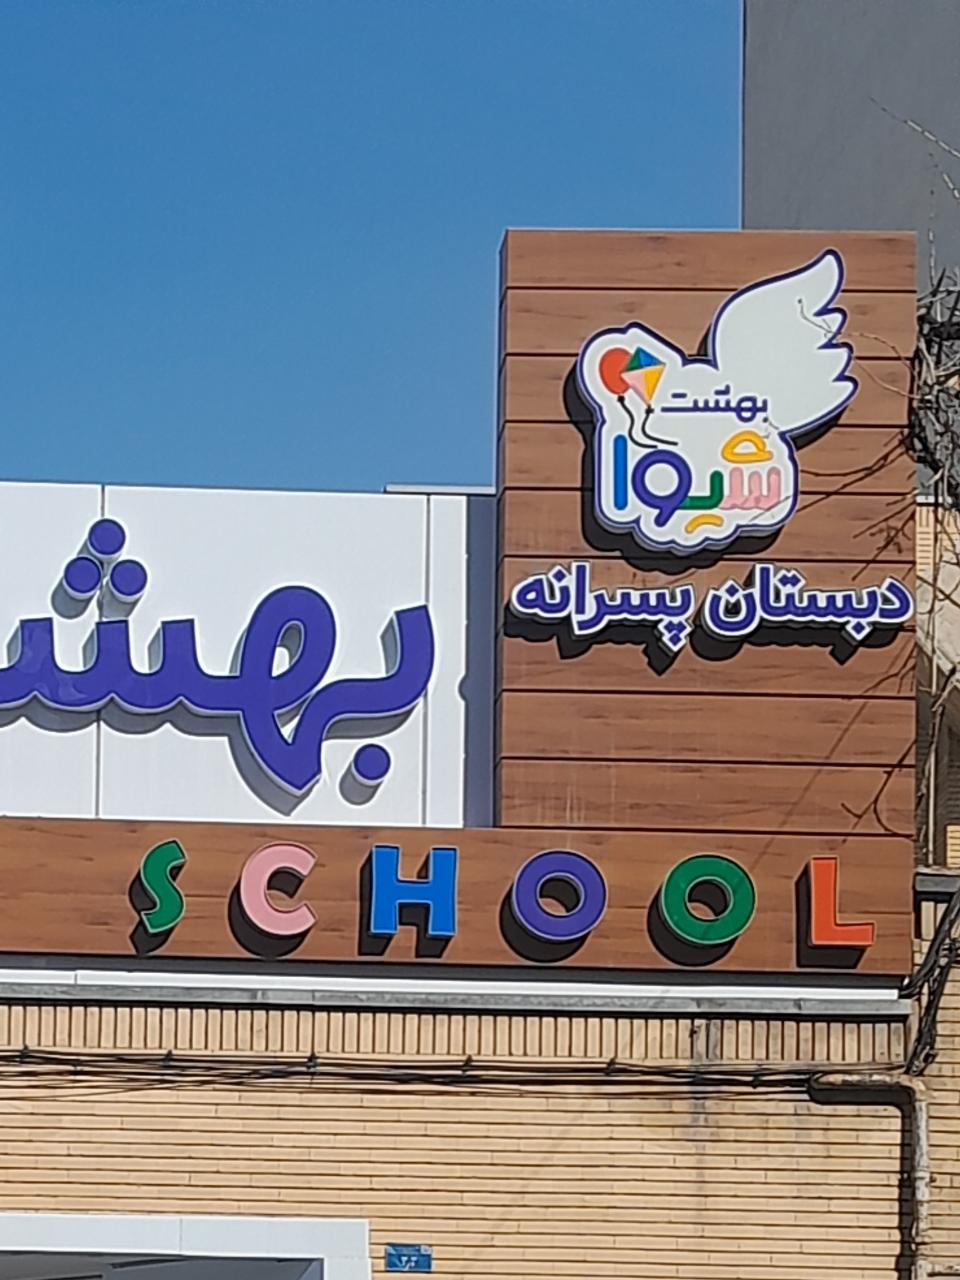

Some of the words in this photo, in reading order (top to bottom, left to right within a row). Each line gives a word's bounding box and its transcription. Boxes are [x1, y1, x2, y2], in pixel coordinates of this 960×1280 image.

[660, 383, 769, 424] بهشت
[513, 562, 695, 649] پسرانه
[708, 564, 911, 638] دبستان
[138, 837, 877, 948] SCHOOL
